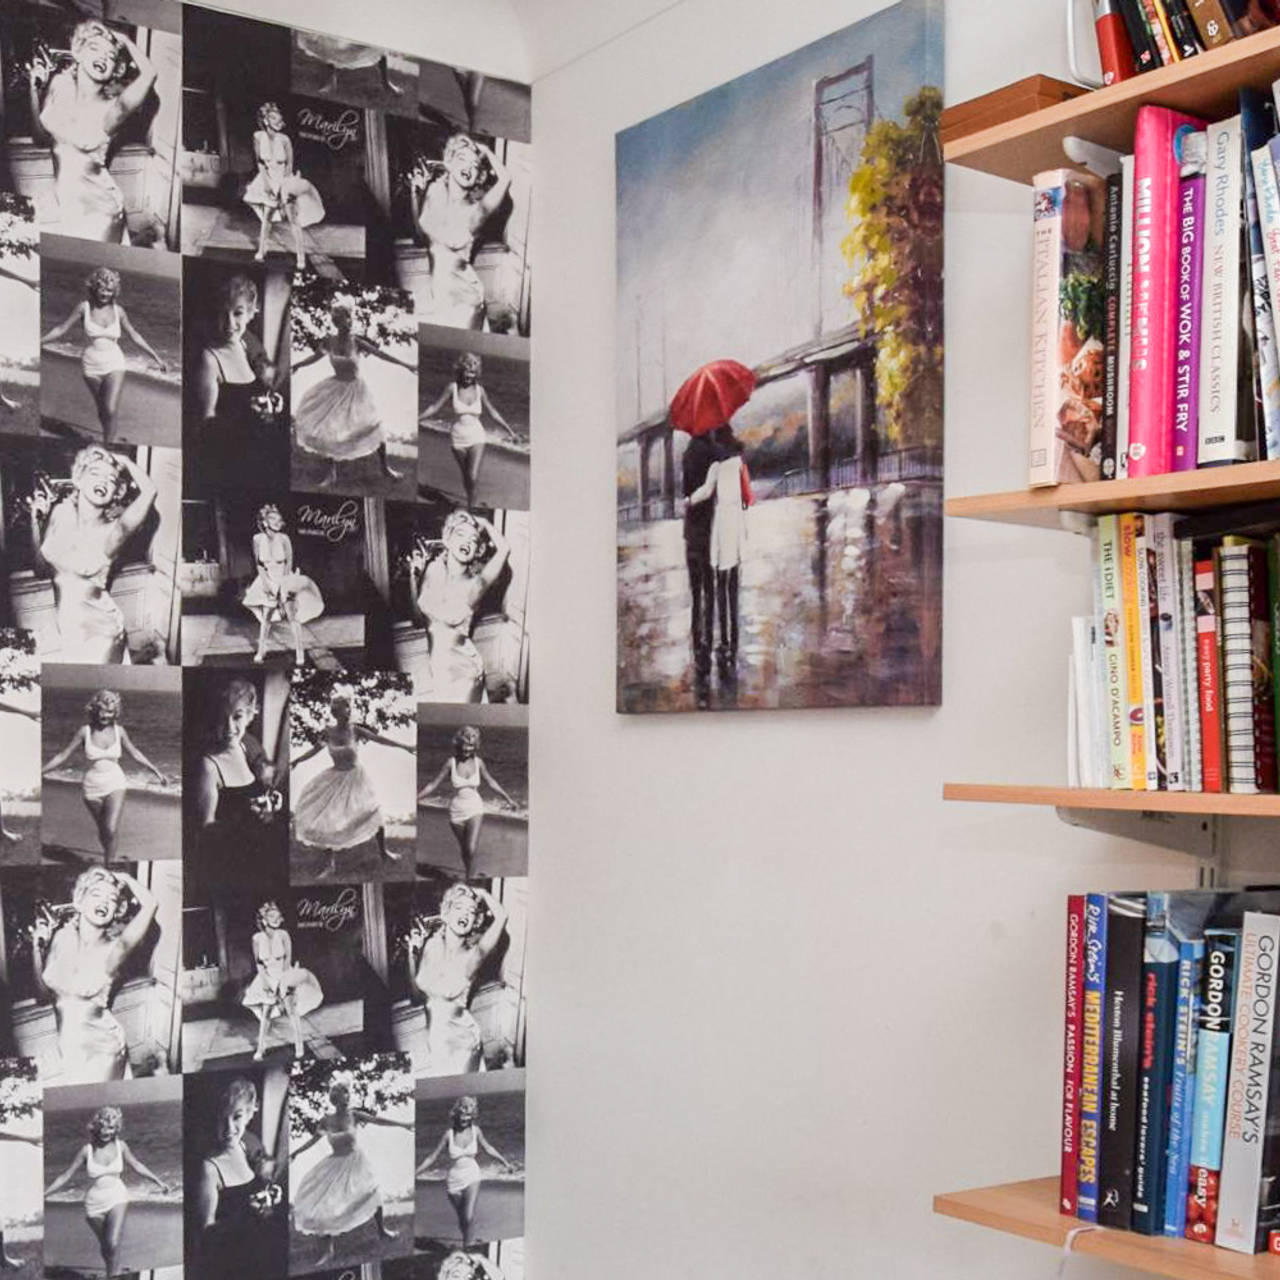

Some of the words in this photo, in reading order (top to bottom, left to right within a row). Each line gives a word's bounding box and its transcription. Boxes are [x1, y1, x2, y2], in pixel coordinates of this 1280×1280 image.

[1215, 132, 1233, 174] Gary
[1110, 187, 1119, 232] Antonio
[1183, 188, 1194, 213] THE
[1214, 177, 1231, 236] Rhodes
[1184, 217, 1194, 243] BIG
[1107, 235, 1118, 289] Carluccio
[1182, 246, 1191, 283] BOOK
[1213, 245, 1223, 278] NEW
[1182, 284, 1190, 301] OF
[1212, 283, 1224, 341] BRITISH
[1180, 304, 1192, 343] WOK
[1180, 350, 1189, 360] &
[1106, 357, 1115, 415] MUSHROOM
[1178, 365, 1189, 398] STIR
[1210, 346, 1223, 414] CLASSICS
[1177, 404, 1188, 432] FRY
[1103, 541, 1113, 564] THE
[1109, 654, 1119, 684] GINO
[1202, 662, 1212, 686] party
[1111, 689, 1122, 747] D'ACAMPO
[1204, 690, 1214, 712] food
[1070, 914, 1079, 964] GORDON
[1180, 960, 1191, 998] RICK
[1239, 933, 1256, 998] ULTIMATE
[1250, 935, 1275, 1038] GORDON
[1068, 967, 1078, 1018] RAMSAY'S
[1146, 973, 1159, 1008] rick
[1206, 951, 1226, 1029] GORDON
[1067, 1025, 1076, 1073] PASSION
[1082, 991, 1101, 1113] MEDITERRANEAN
[1176, 1006, 1189, 1065] STEIN'S
[1233, 1003, 1251, 1073] COOKERY
[1111, 1030, 1123, 1090] Blumenthal
[1066, 1081, 1074, 1100] FOR
[1141, 1077, 1151, 1123] seafood
[1230, 1075, 1245, 1139] COURSE
[1244, 1042, 1267, 1144] RAMSAY'S
[1064, 1103, 1074, 1153] FLAVOUR
[1109, 1102, 1119, 1131] home
[1080, 1120, 1097, 1183] ESCAPES
[1136, 1167, 1147, 1199] guide
[1195, 1169, 1209, 1207] easy
